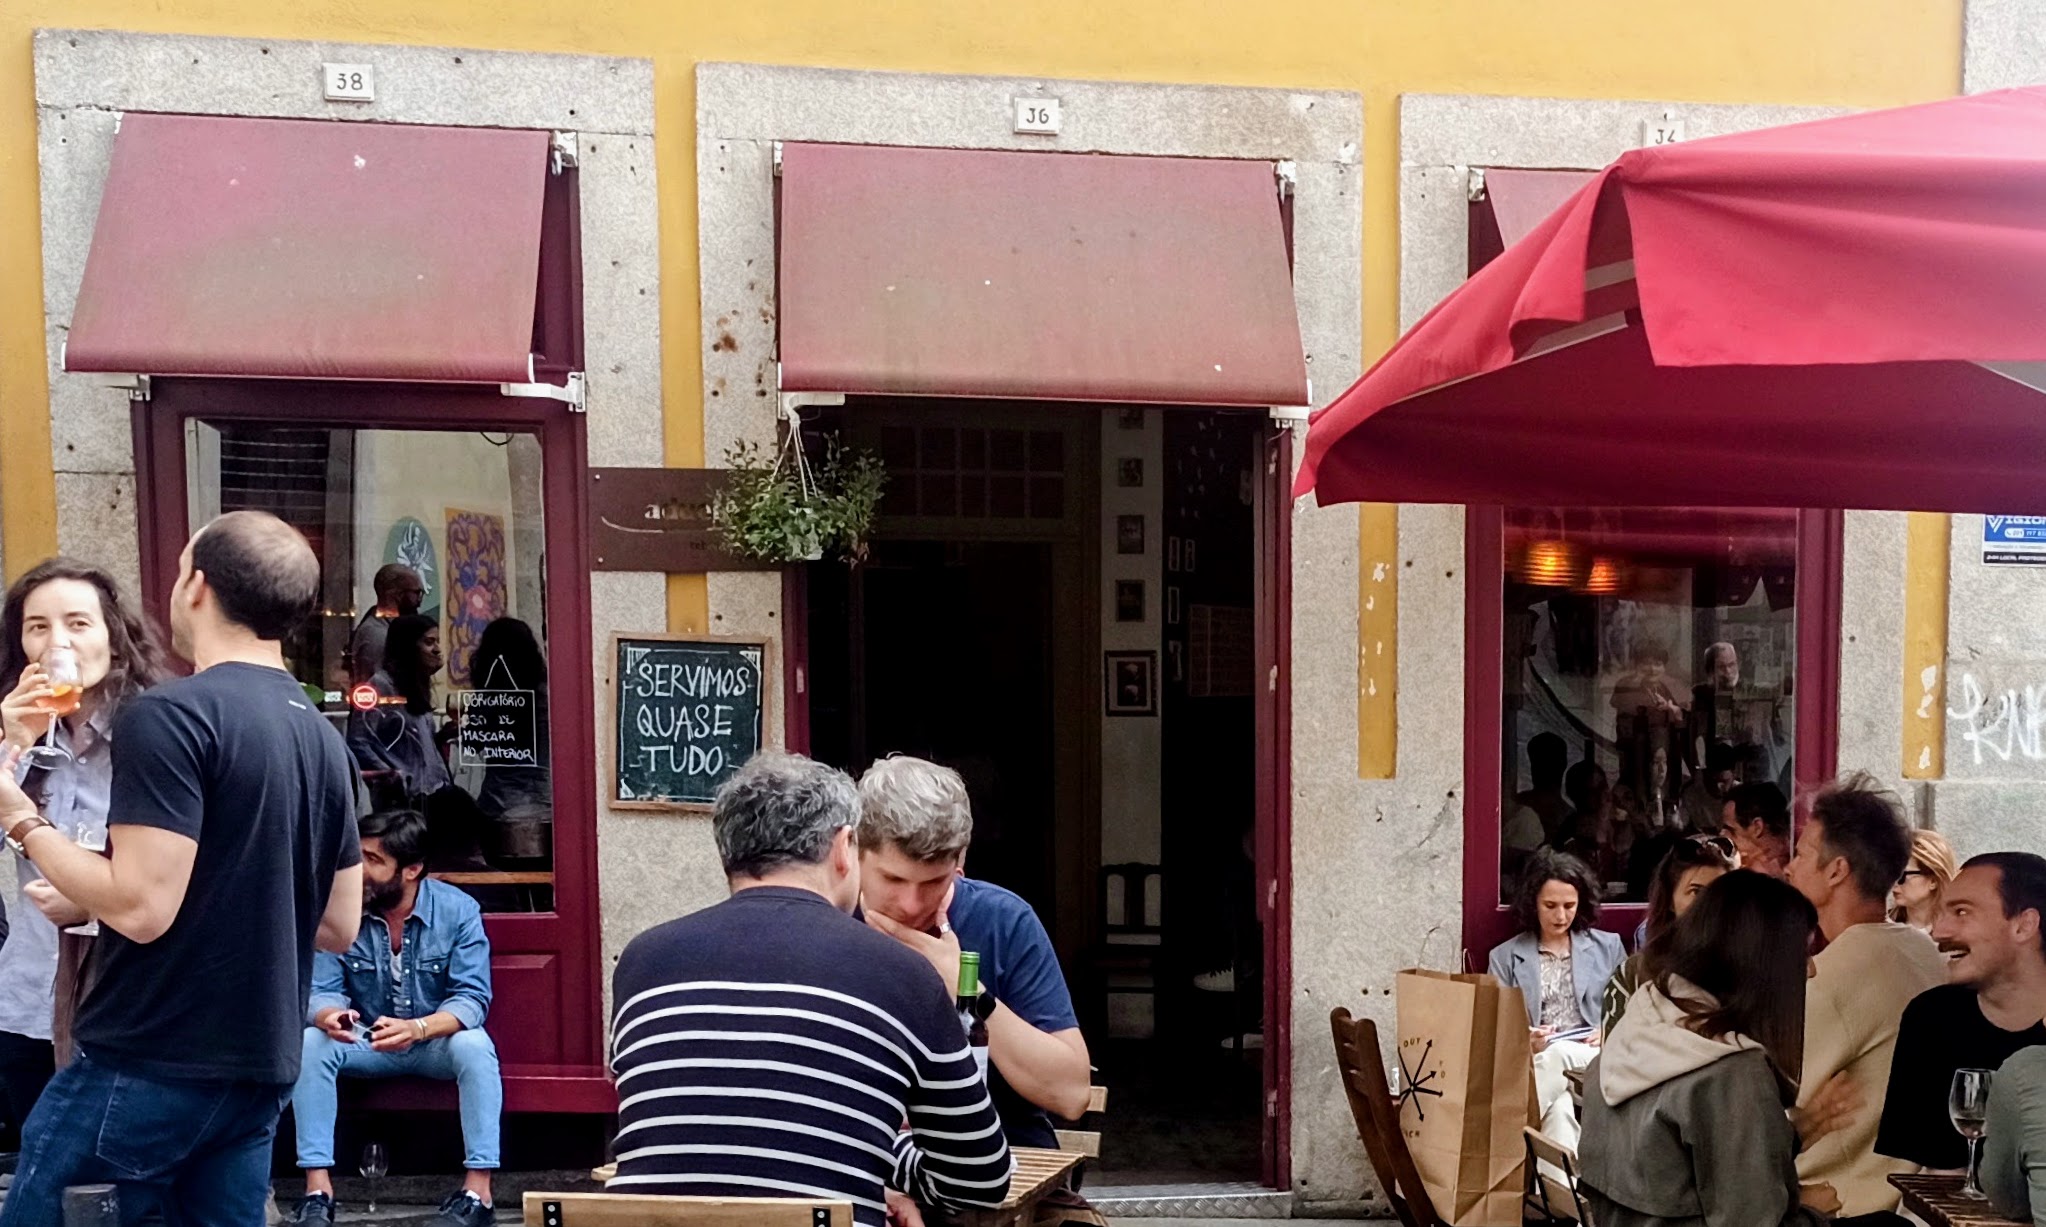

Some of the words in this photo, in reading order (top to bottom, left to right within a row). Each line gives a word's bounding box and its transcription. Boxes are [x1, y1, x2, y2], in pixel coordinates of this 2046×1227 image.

[336, 72, 363, 91] 38
[636, 703, 734, 743] QUASE
[463, 729, 516, 743] MASCARA
[463, 745, 477, 757] NO
[483, 746, 535, 762] INTERIOR
[639, 744, 724, 777] TUDO
[1403, 1037, 1421, 1049] OUT
